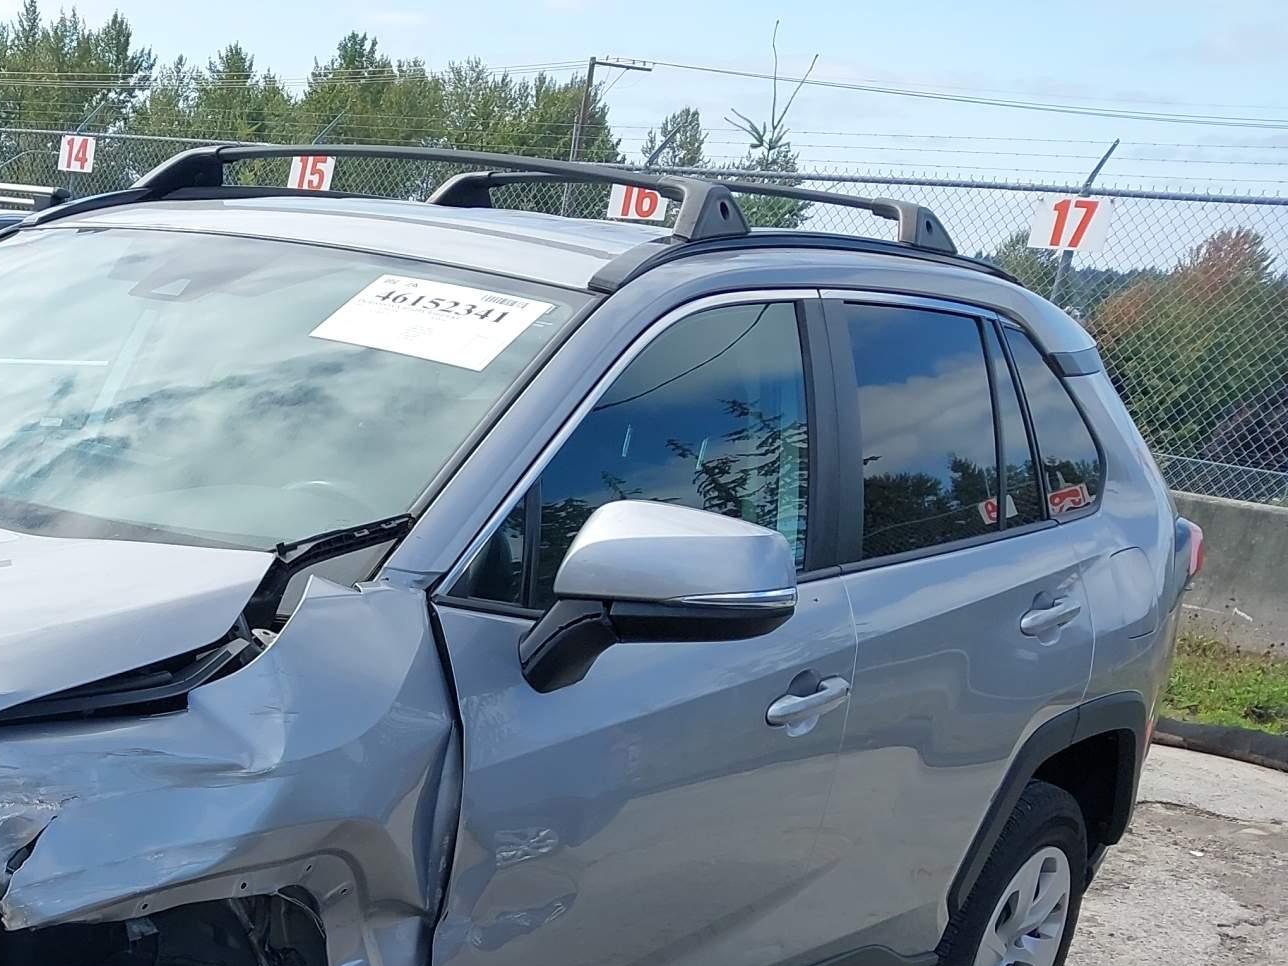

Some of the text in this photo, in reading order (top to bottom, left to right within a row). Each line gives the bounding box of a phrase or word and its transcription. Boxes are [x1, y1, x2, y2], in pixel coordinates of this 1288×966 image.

[65, 137, 89, 169] 14
[297, 155, 328, 189] 15
[621, 184, 658, 218] 16
[1049, 199, 1097, 248] 17
[376, 289, 510, 324] 46152341
